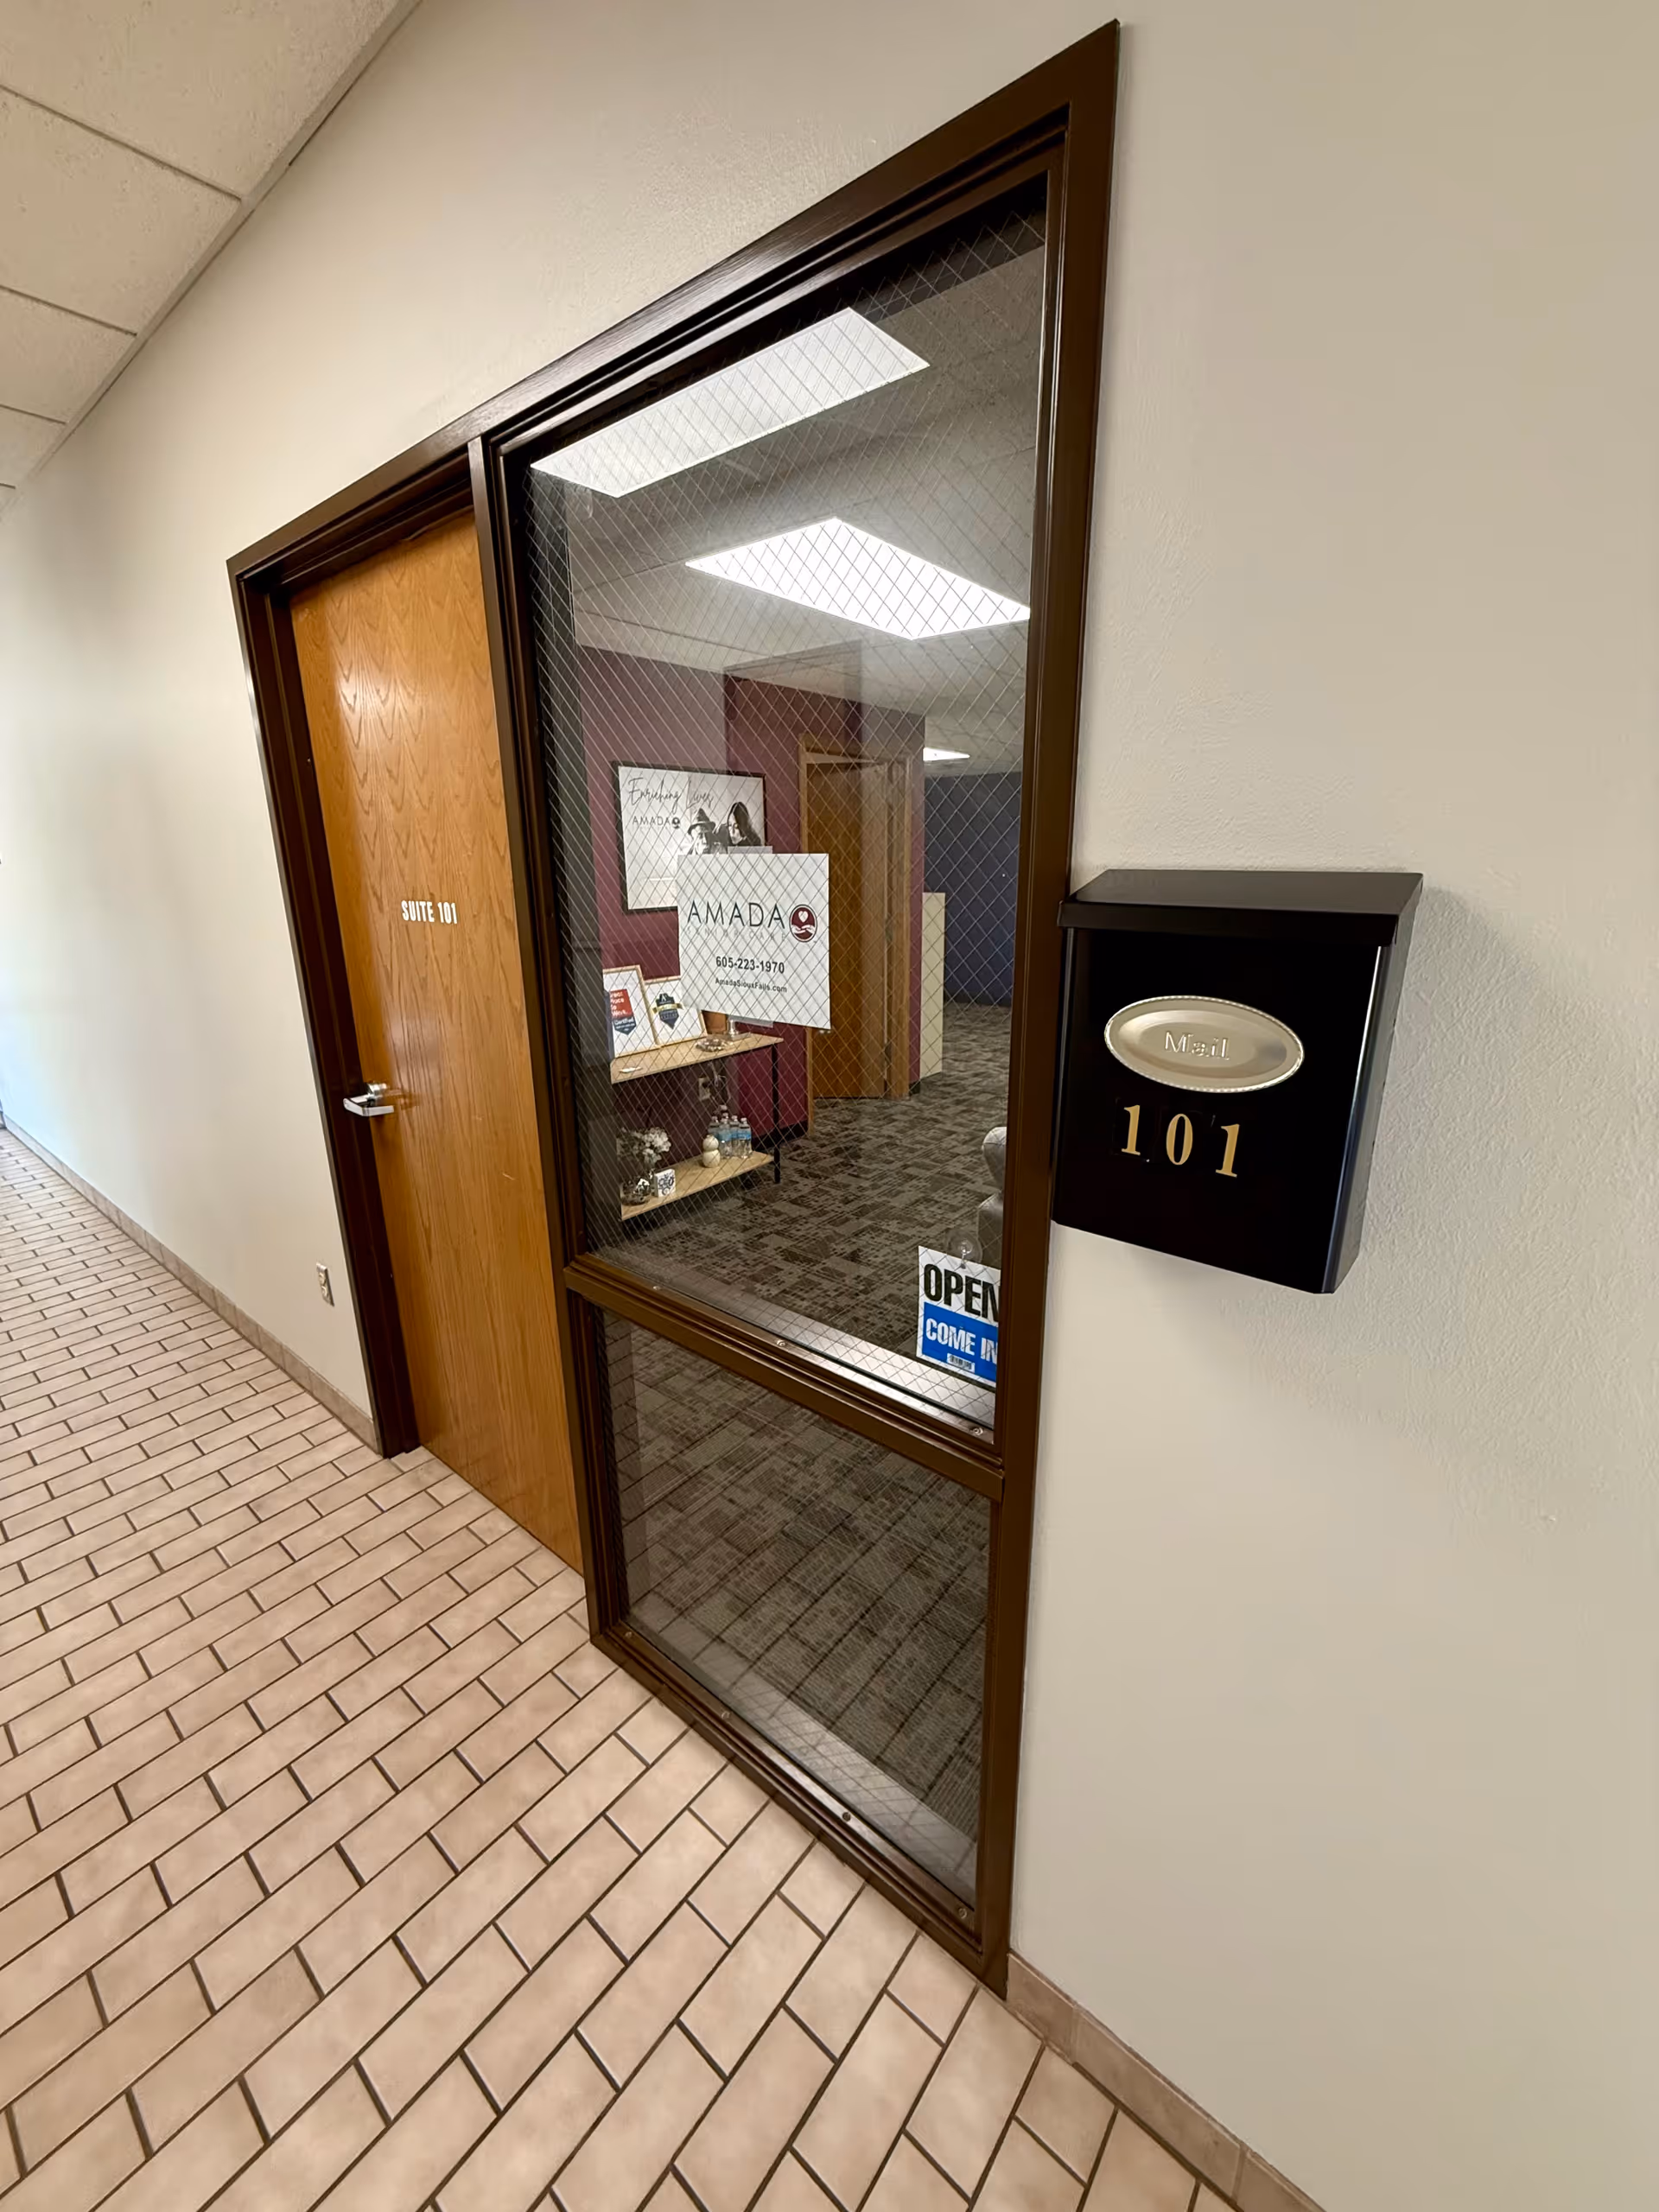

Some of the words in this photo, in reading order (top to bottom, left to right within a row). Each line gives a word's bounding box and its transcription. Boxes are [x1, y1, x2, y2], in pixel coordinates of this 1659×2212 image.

[628, 777, 682, 814] Enriching
[632, 815, 671, 826] AMADA
[401, 899, 435, 923] SUITE
[437, 901, 458, 925] 101
[687, 900, 785, 929] AMADA
[715, 957, 785, 974] 605-223-1970
[715, 977, 787, 993] AmadaSiouxFalls.com
[1164, 1031, 1230, 1060] Mail
[1122, 1104, 1240, 1178] 101
[924, 1263, 999, 1323] OPEN
[925, 1318, 976, 1356] COME
[980, 1337, 998, 1364] IN
